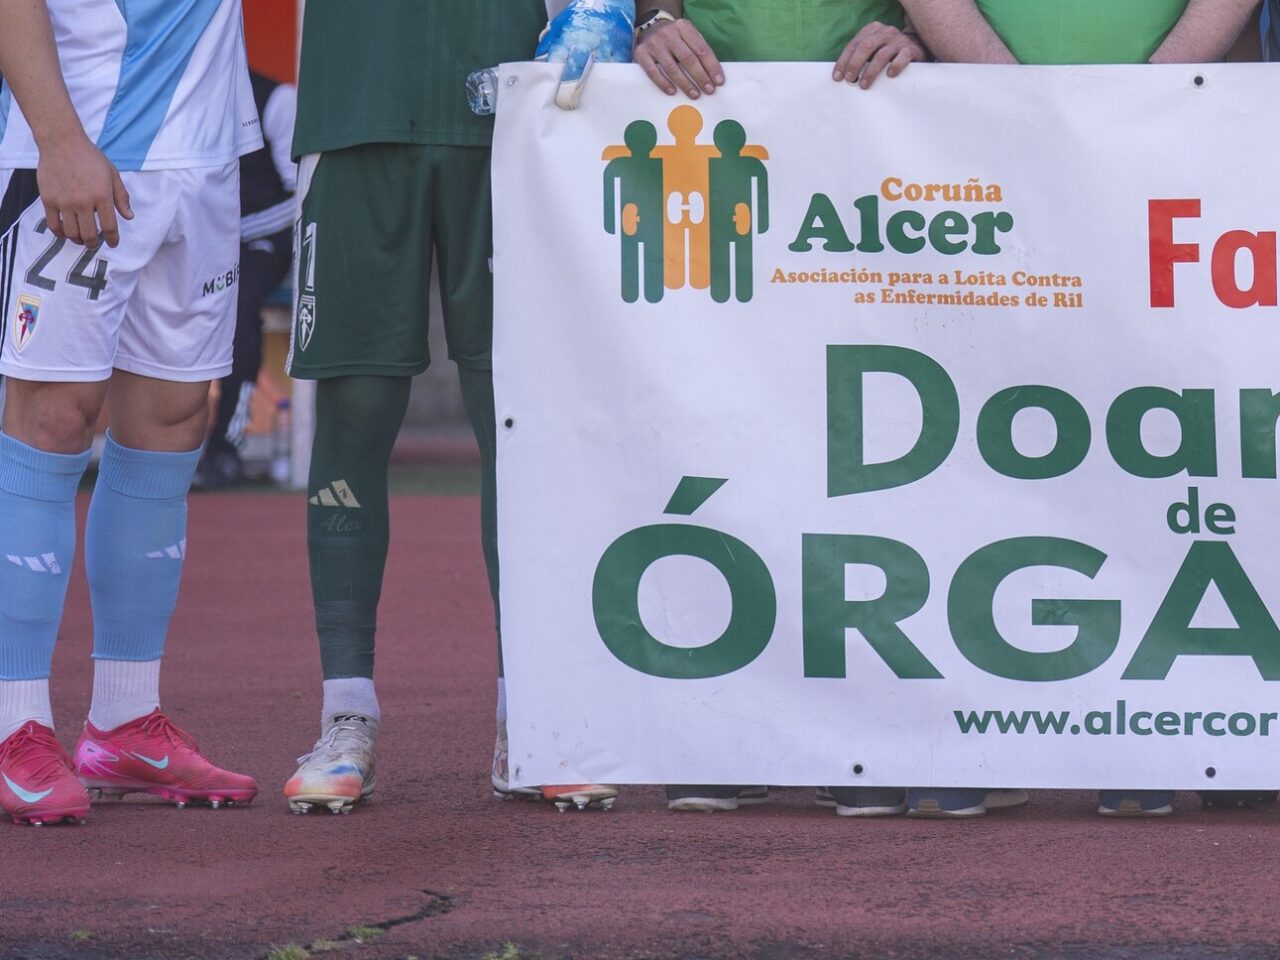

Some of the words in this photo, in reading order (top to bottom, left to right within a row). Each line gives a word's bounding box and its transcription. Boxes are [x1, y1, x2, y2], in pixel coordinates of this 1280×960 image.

[881, 177, 1003, 203] Coruña
[788, 193, 1014, 256] Alcer
[24, 217, 109, 300] 24
[771, 268, 883, 284] Asociación
[888, 271, 933, 287] para
[938, 273, 949, 285] a
[954, 270, 1007, 286] Loita
[1011, 271, 1083, 288] Contra
[854, 292, 876, 304] as
[880, 289, 1020, 307] Enfermidades
[1025, 292, 1048, 307] de
[1053, 292, 1084, 308] Ril
[1166, 486, 1237, 534] de
